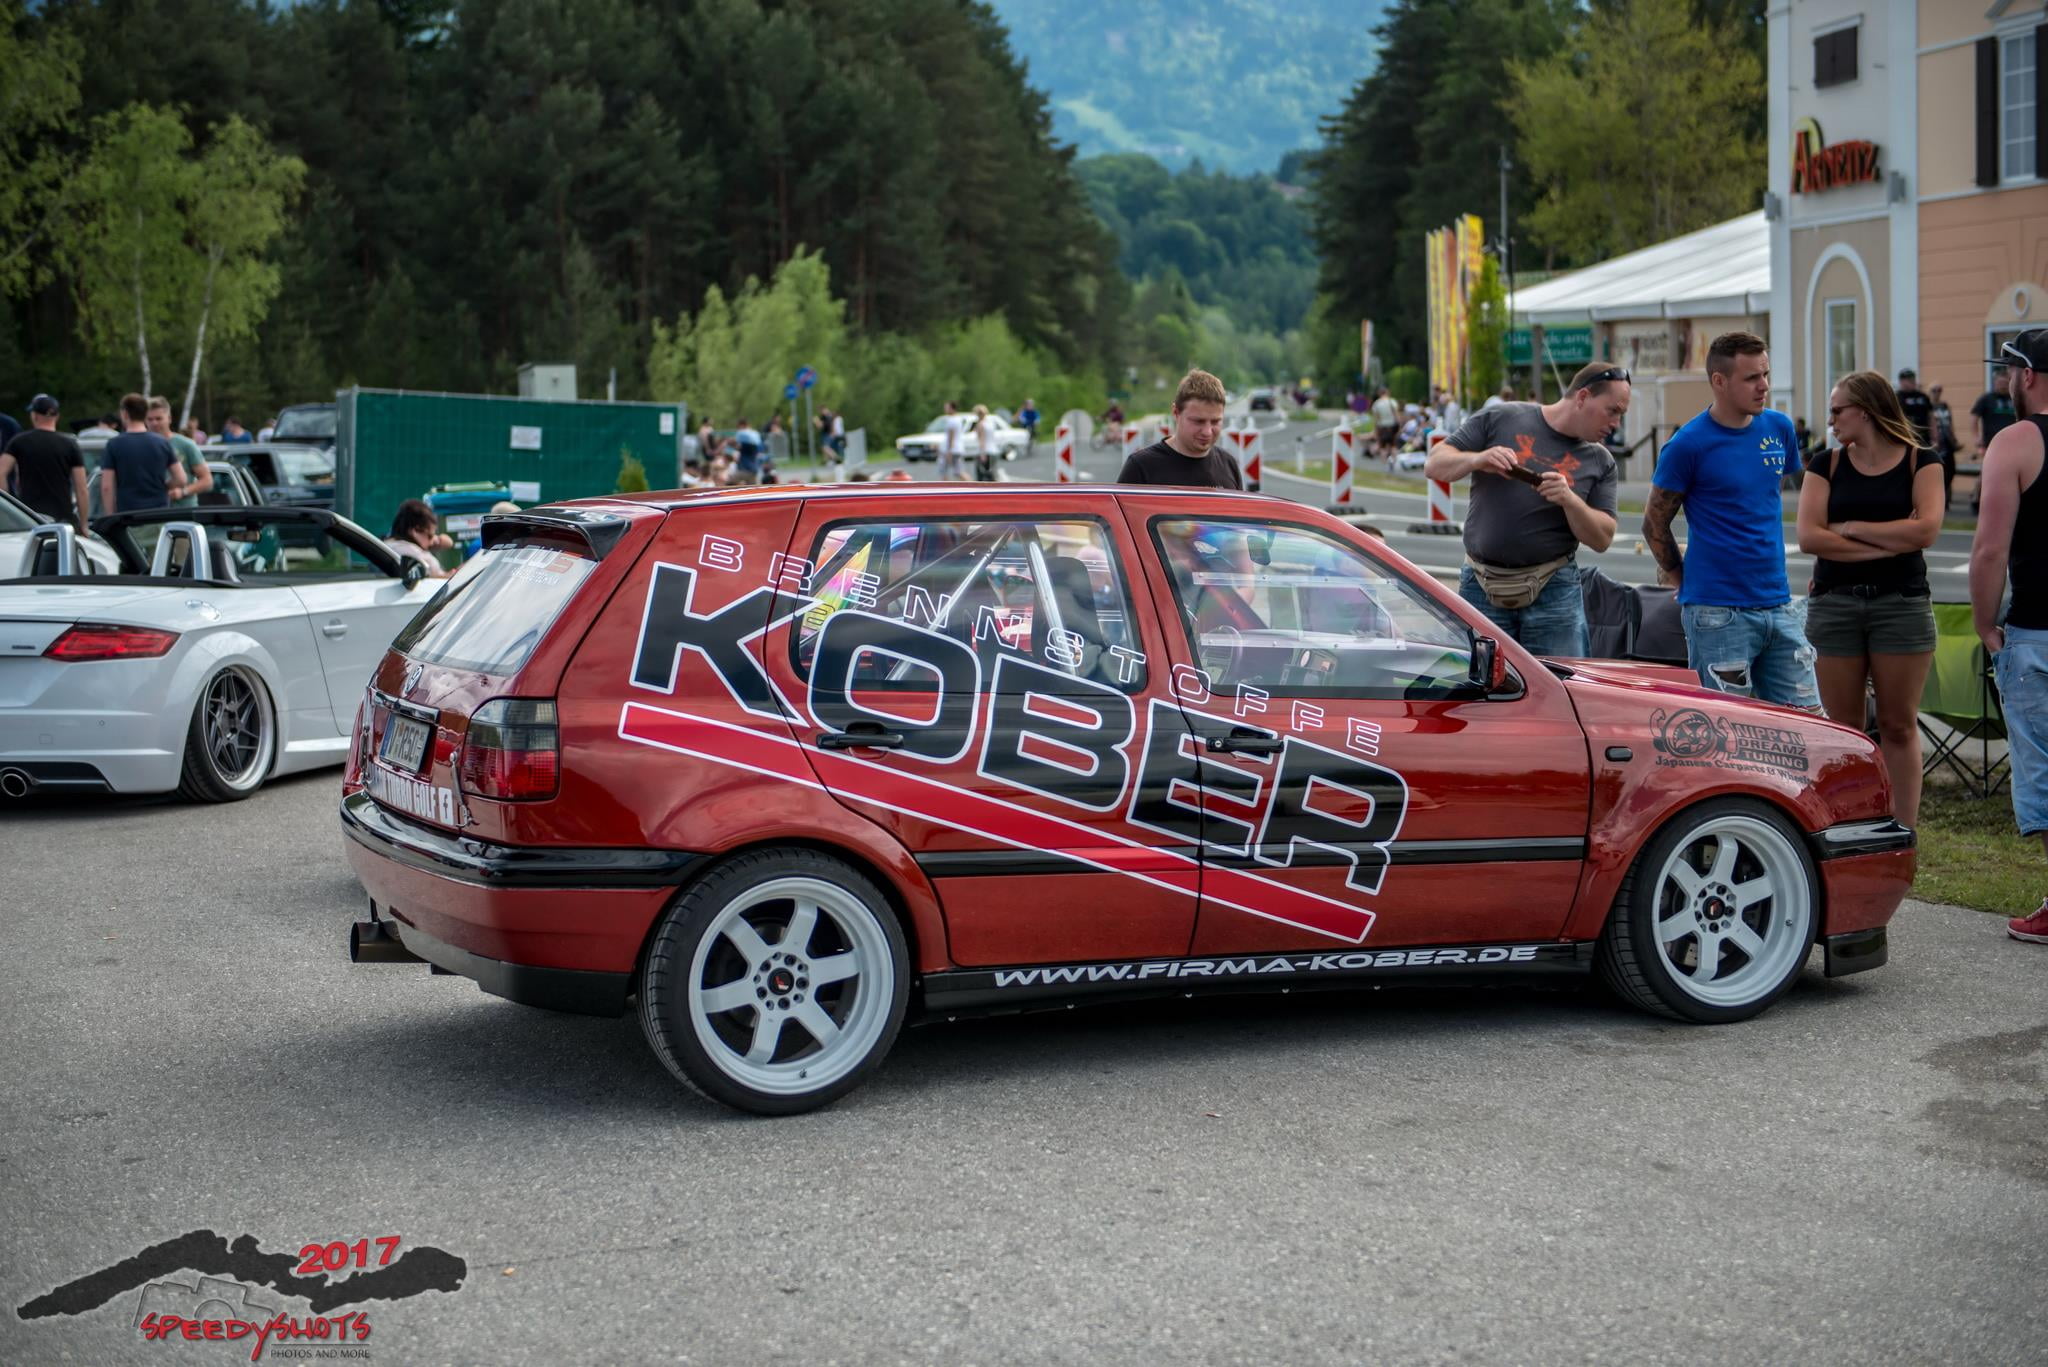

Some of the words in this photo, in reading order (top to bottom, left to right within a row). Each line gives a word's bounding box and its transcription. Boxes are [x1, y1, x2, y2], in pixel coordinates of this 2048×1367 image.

[698, 534, 1382, 756] BRENNSTOFFE
[629, 561, 1409, 896] KOBER
[1738, 738, 1807, 756] DREAMZ
[1655, 755, 1712, 768] Japanese
[1714, 760, 1767, 774] Carparts
[1744, 750, 1805, 769] TUNING
[413, 781, 435, 818] GOLF
[994, 946, 1539, 987] WWW.FIRMA-KOBER.DE
